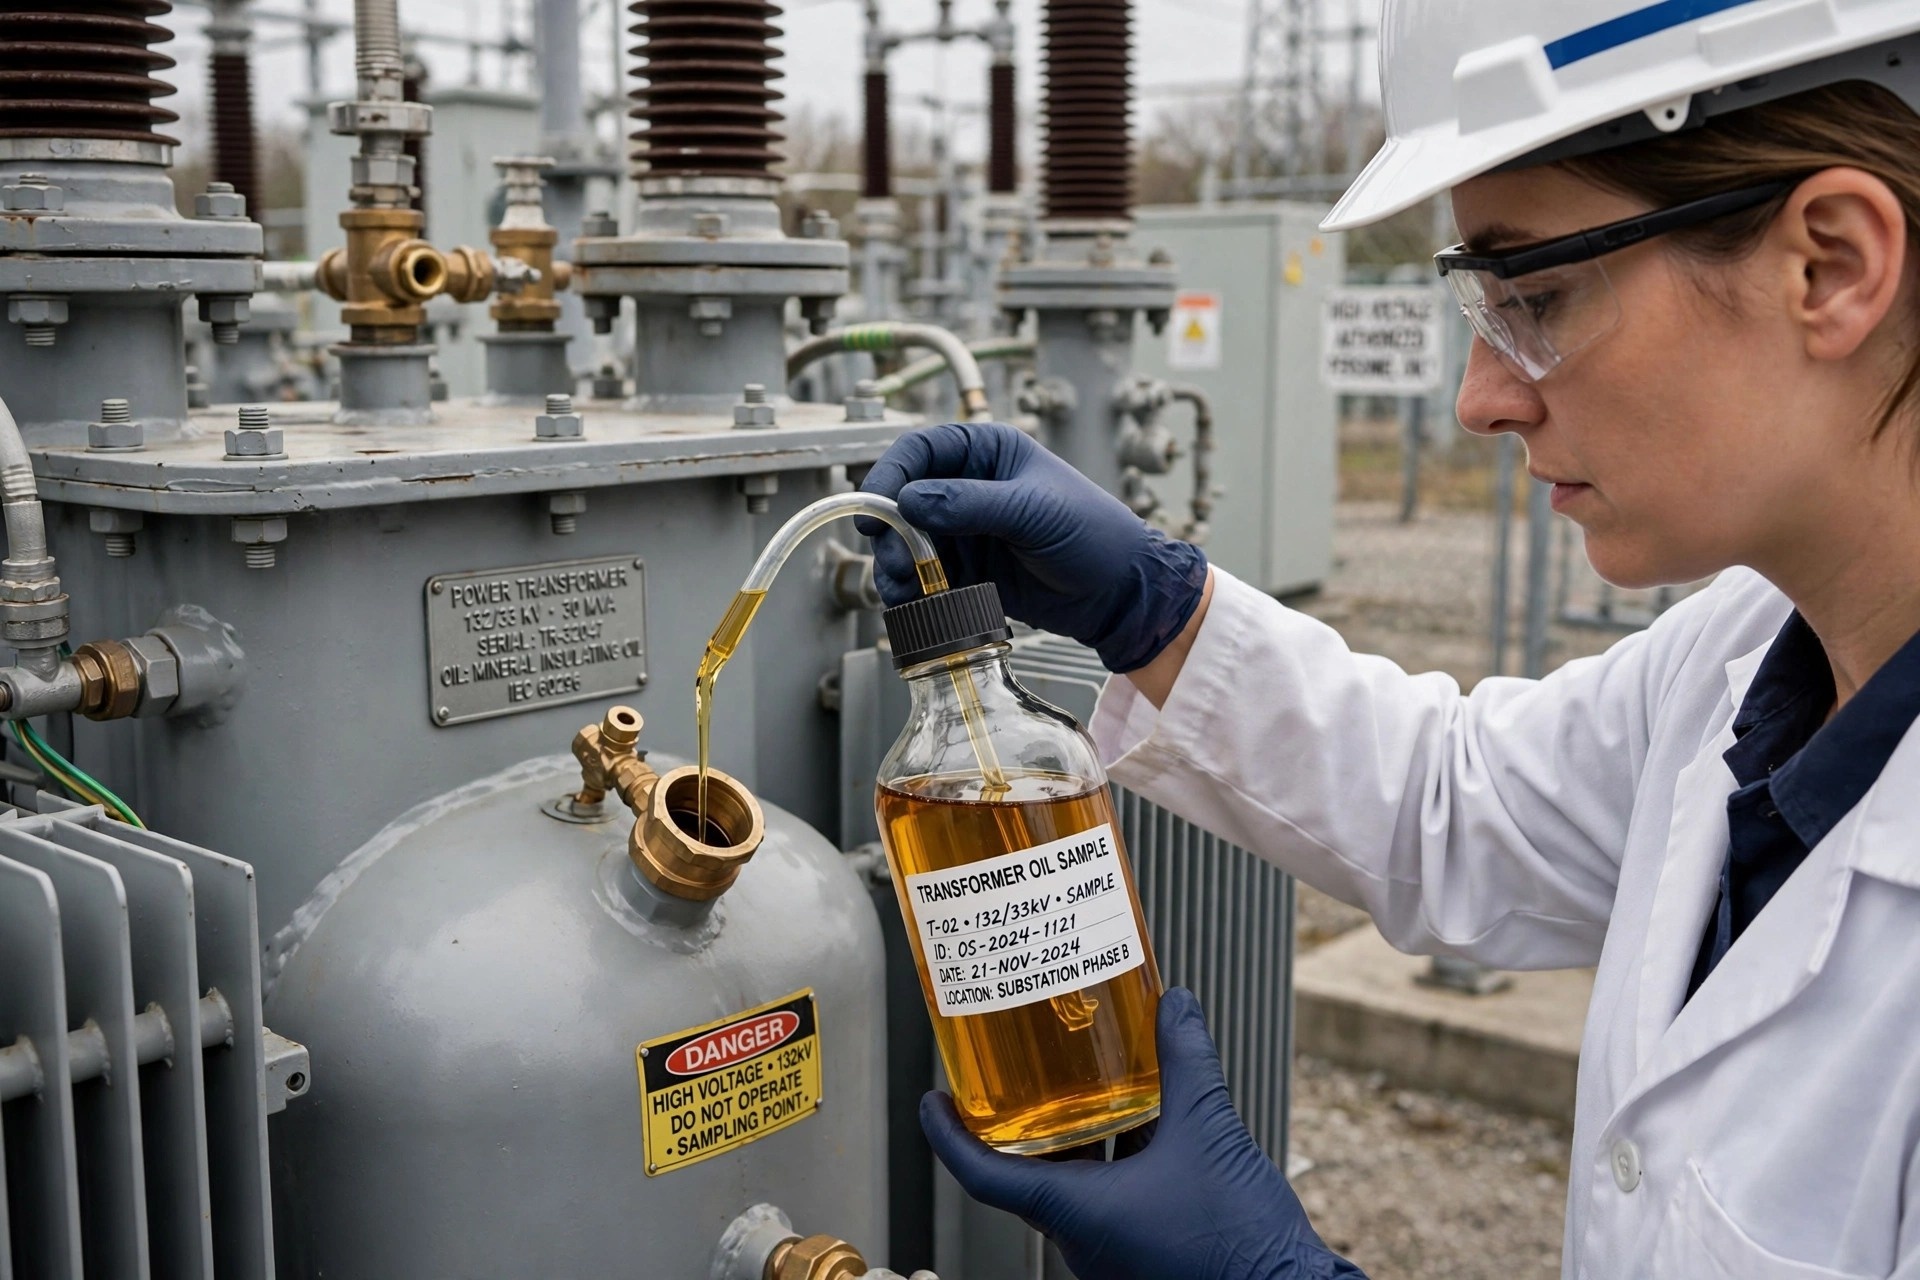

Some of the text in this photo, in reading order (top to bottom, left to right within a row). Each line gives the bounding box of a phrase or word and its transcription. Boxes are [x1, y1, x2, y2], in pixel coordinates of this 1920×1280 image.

[451, 566, 628, 608] POWER TRANSFORMER
[464, 593, 616, 633] 132/33 KV 30 MVA
[440, 637, 644, 688] OIL: MINERAL INSULATING OIL
[477, 631, 536, 657] SERIAL:
[508, 679, 534, 703] IEC
[917, 837, 1110, 904] TRANSFORMER OIL SAMPLE
[926, 872, 1115, 937] T-02 132/33kV SAMPLE
[934, 943, 952, 960] ID:
[939, 937, 1081, 983] DATE: 21-NOV-2024
[944, 943, 1130, 1006] LOCATION: SUBSTATION PHASE B
[685, 1018, 784, 1070] DANGER
[653, 1041, 812, 1115] HIGH VOLTAGE 132kV
[671, 1069, 802, 1134] DO NOT OPERATE
[677, 1091, 802, 1156] SAMPLING POINT
